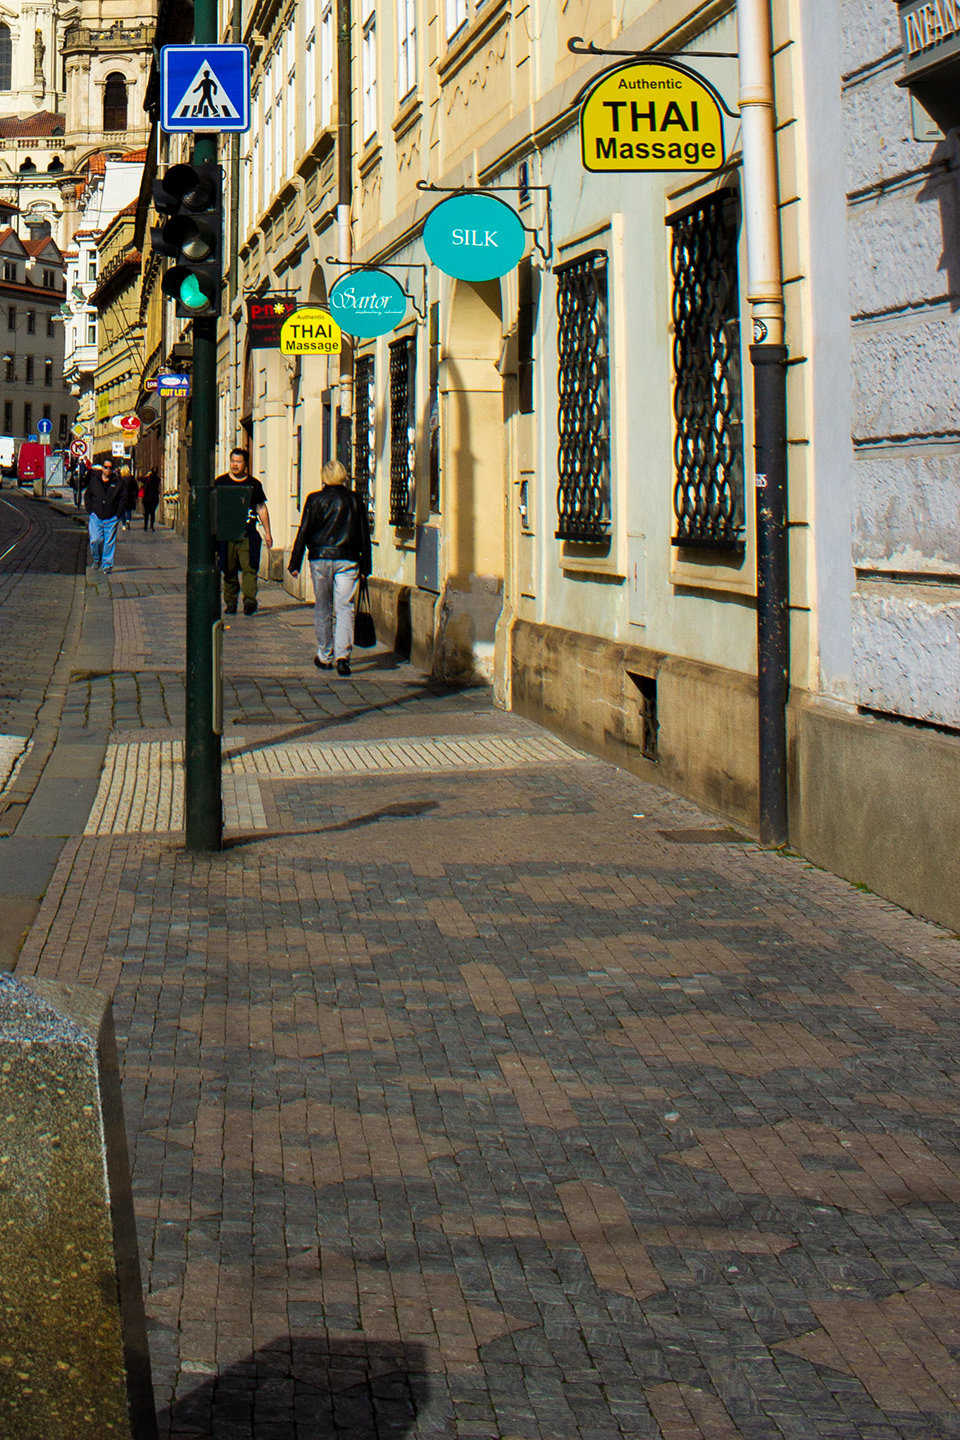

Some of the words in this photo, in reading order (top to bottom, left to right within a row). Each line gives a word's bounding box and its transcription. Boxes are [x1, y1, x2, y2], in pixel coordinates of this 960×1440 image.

[618, 78, 683, 89] Authentic
[602, 100, 699, 132] THAI
[595, 137, 716, 165] Massage
[451, 228, 499, 248] SILK
[331, 287, 393, 309] Sartor
[290, 324, 332, 338] THAI
[286, 341, 339, 352] Massage
